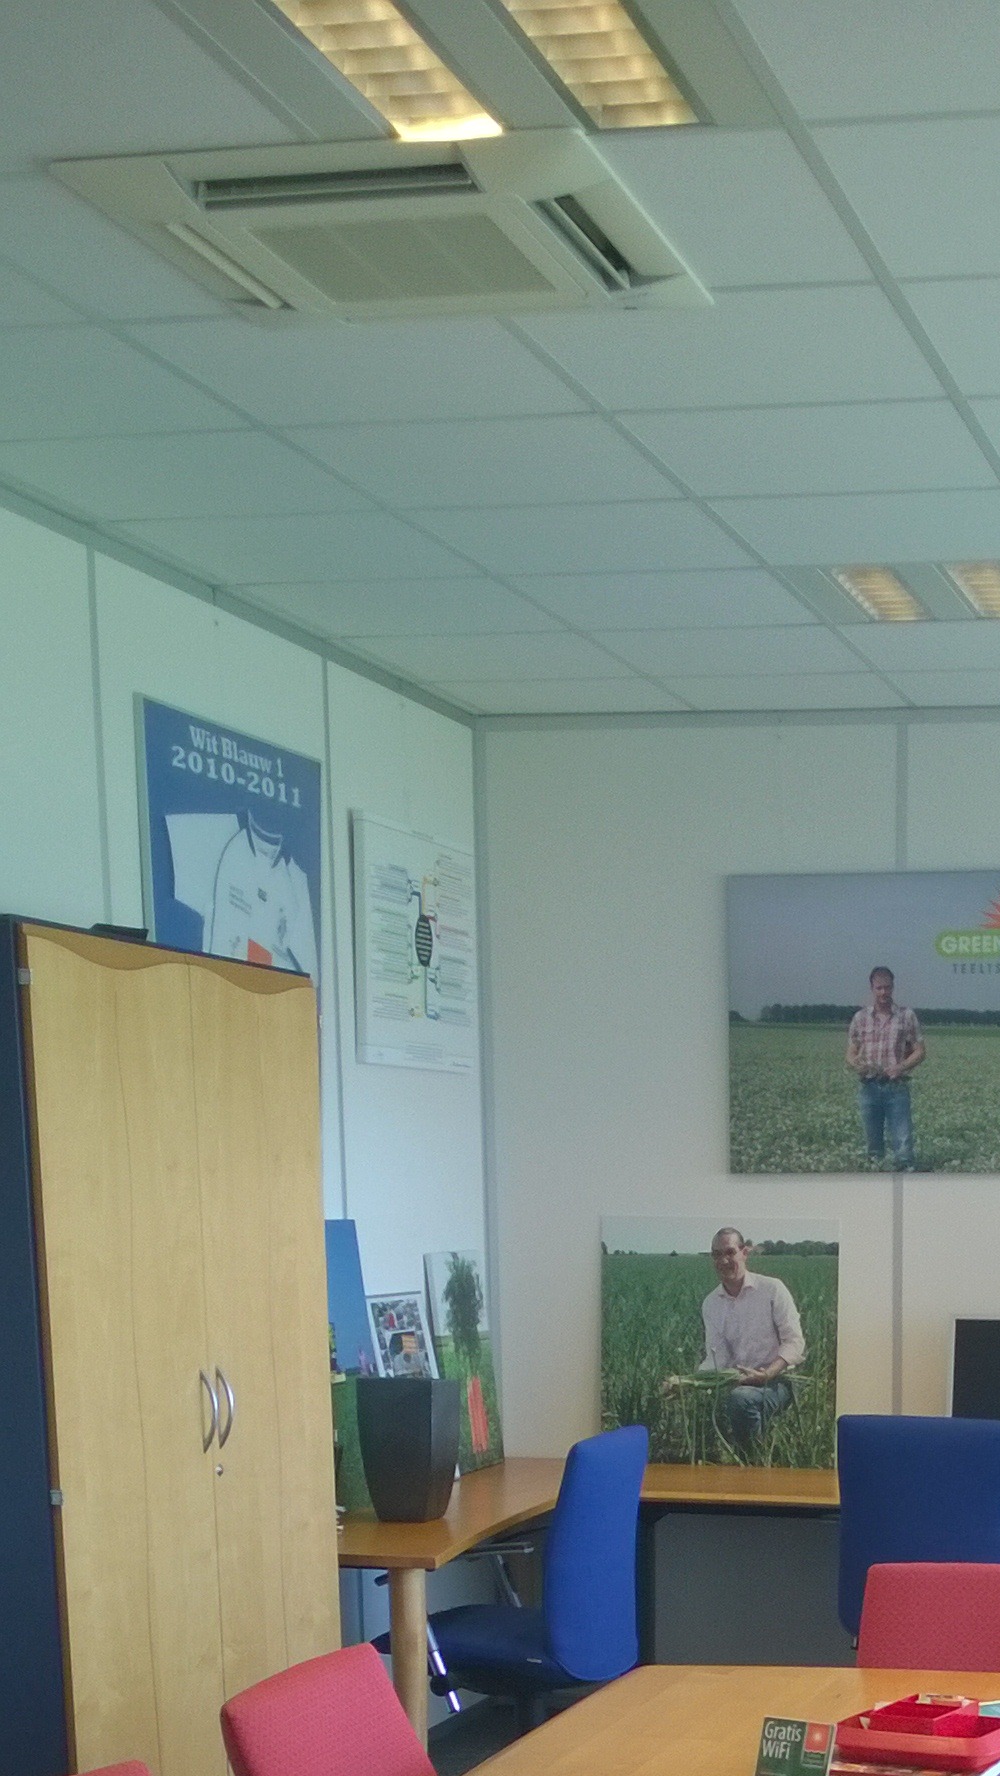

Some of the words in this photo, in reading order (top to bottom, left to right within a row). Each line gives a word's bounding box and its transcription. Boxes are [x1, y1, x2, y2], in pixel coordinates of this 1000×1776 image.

[189, 724, 219, 756] Wit
[220, 736, 272, 773] Blauw
[171, 745, 301, 808] 2010-2011
[762, 1738, 791, 1760] WiFi
[764, 1720, 802, 1743] Gratis
